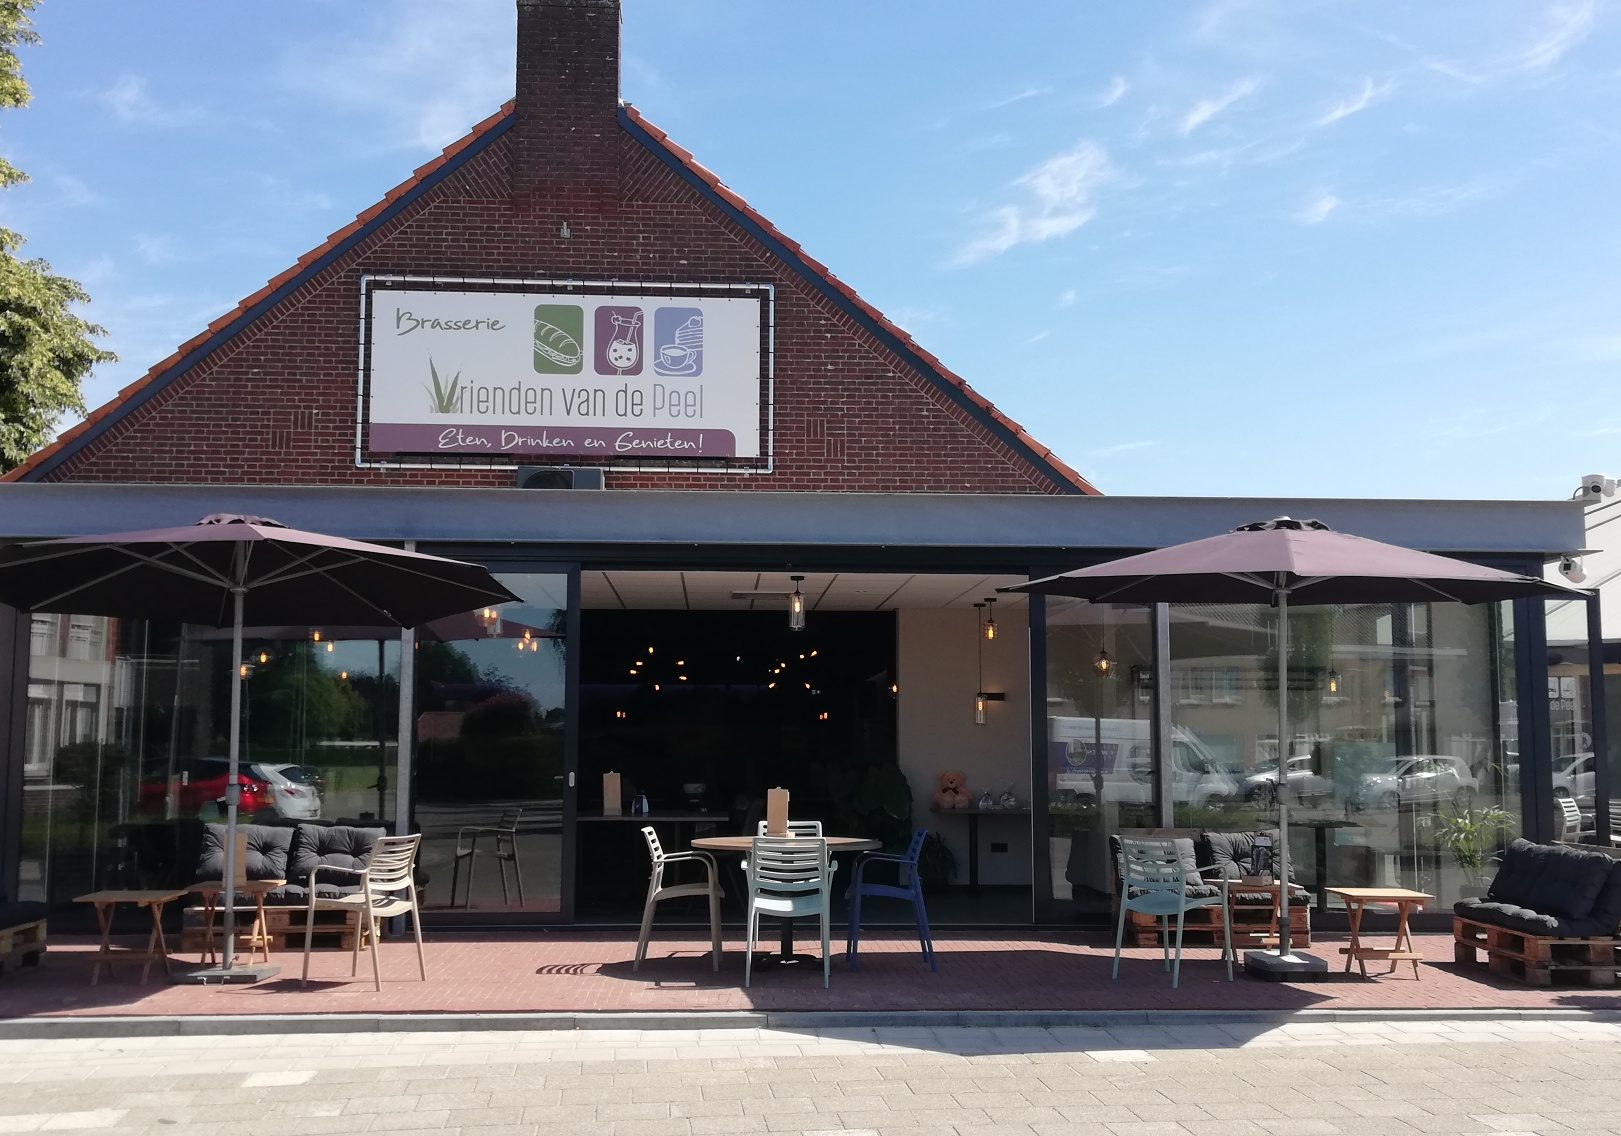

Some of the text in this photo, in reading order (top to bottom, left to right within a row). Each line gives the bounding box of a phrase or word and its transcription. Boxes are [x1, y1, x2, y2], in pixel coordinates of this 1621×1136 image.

[396, 308, 506, 335] Brasserie
[424, 357, 703, 418] Vrienden van de Peel
[438, 428, 704, 454] Eten, Drinken en Genieten!
